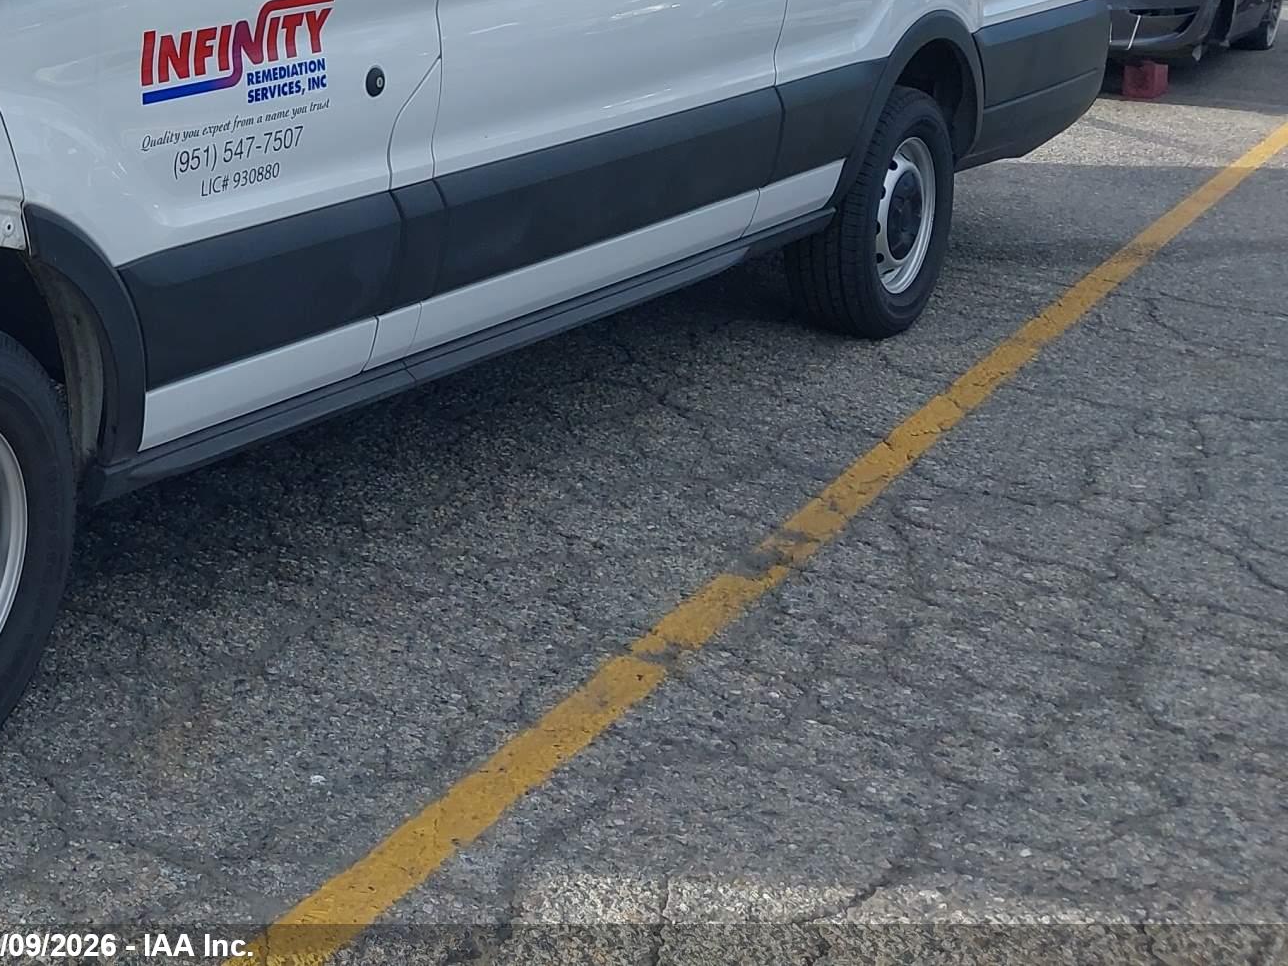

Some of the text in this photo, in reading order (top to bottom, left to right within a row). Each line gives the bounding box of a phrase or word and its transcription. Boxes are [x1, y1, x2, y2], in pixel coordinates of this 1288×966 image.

[246, 58, 326, 86] REMEDIATION
[247, 74, 327, 104] SERVICES, INC
[141, 98, 330, 151] Quality you expect from a name you trust
[174, 125, 304, 179] (951) 547-7507
[200, 162, 280, 197] LIC# 930880
